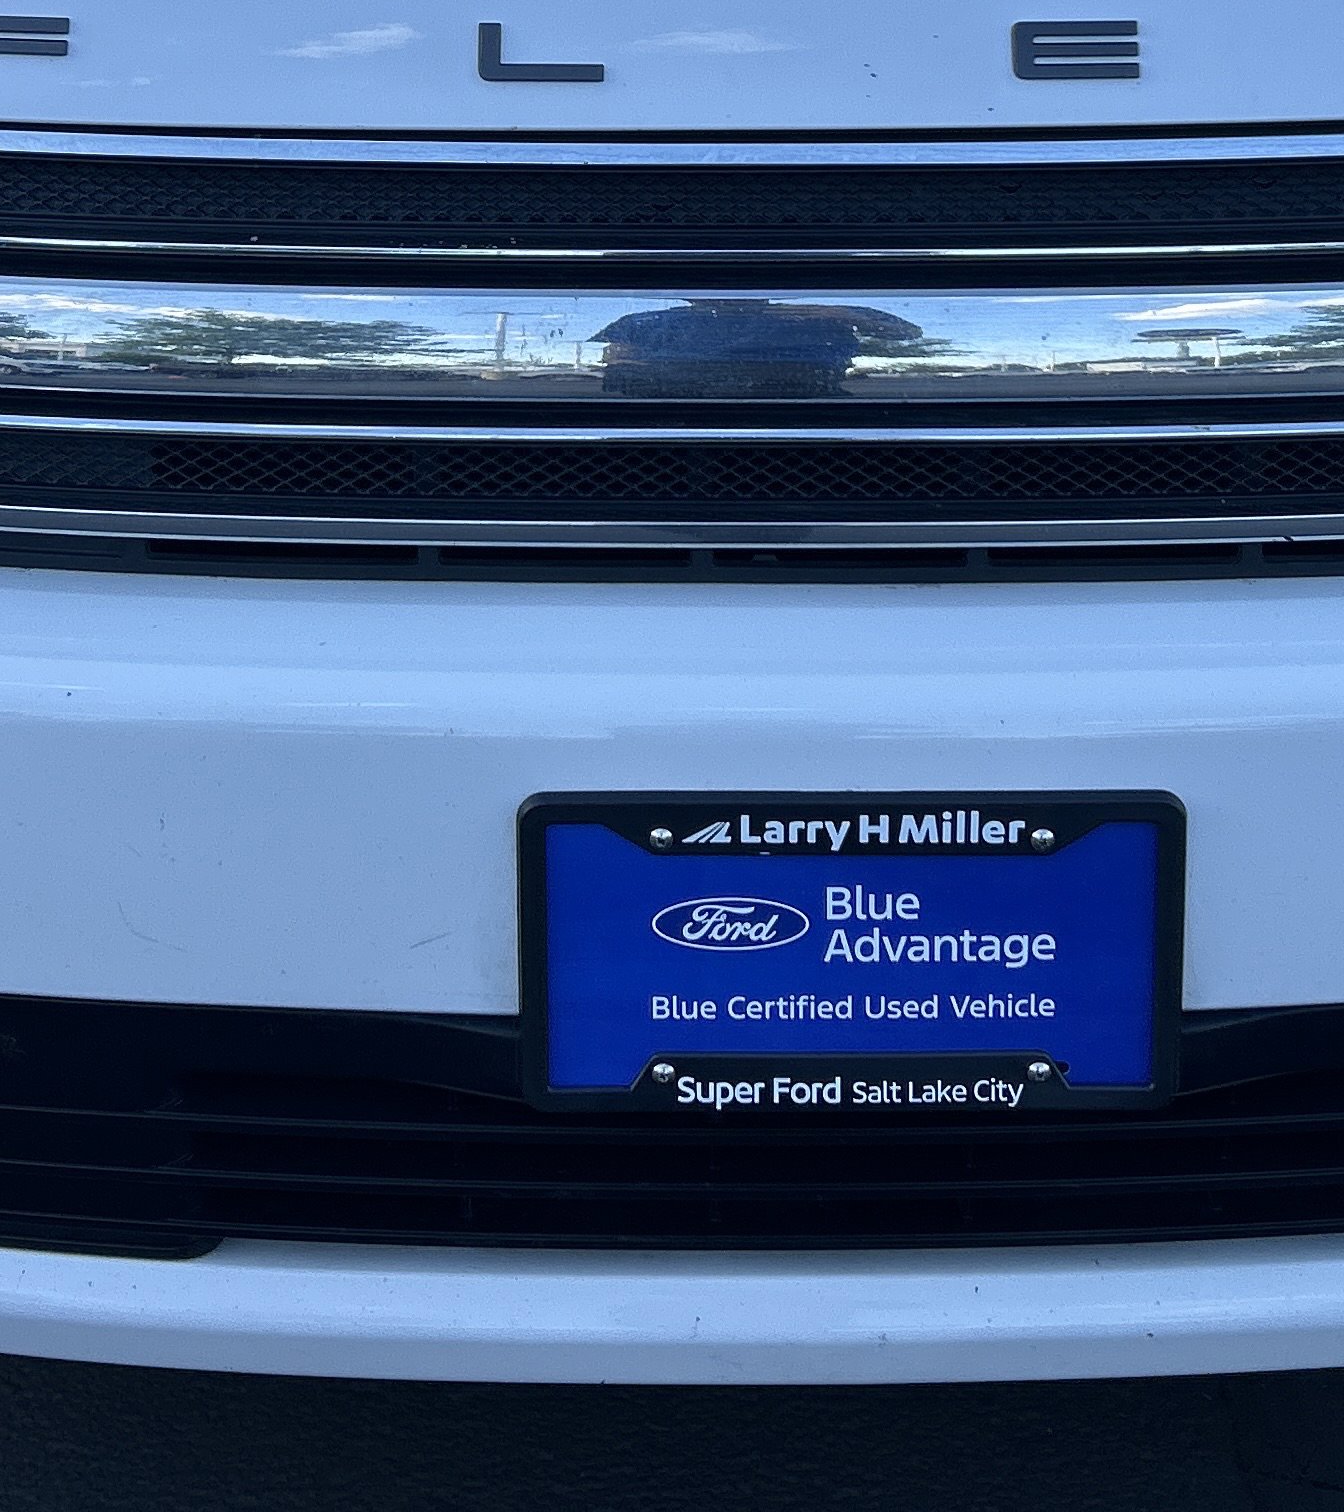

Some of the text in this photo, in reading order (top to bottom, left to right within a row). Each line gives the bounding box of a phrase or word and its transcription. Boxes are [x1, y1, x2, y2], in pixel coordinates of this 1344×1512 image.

[740, 810, 1026, 851] Larry H Miller
[826, 885, 920, 921] Blue
[682, 904, 780, 942] Ford
[824, 926, 1056, 968] Advantage
[652, 992, 1056, 1020] Blue Certified Used Vehicle
[677, 1076, 1024, 1110] Super Ford Salt Lake City
